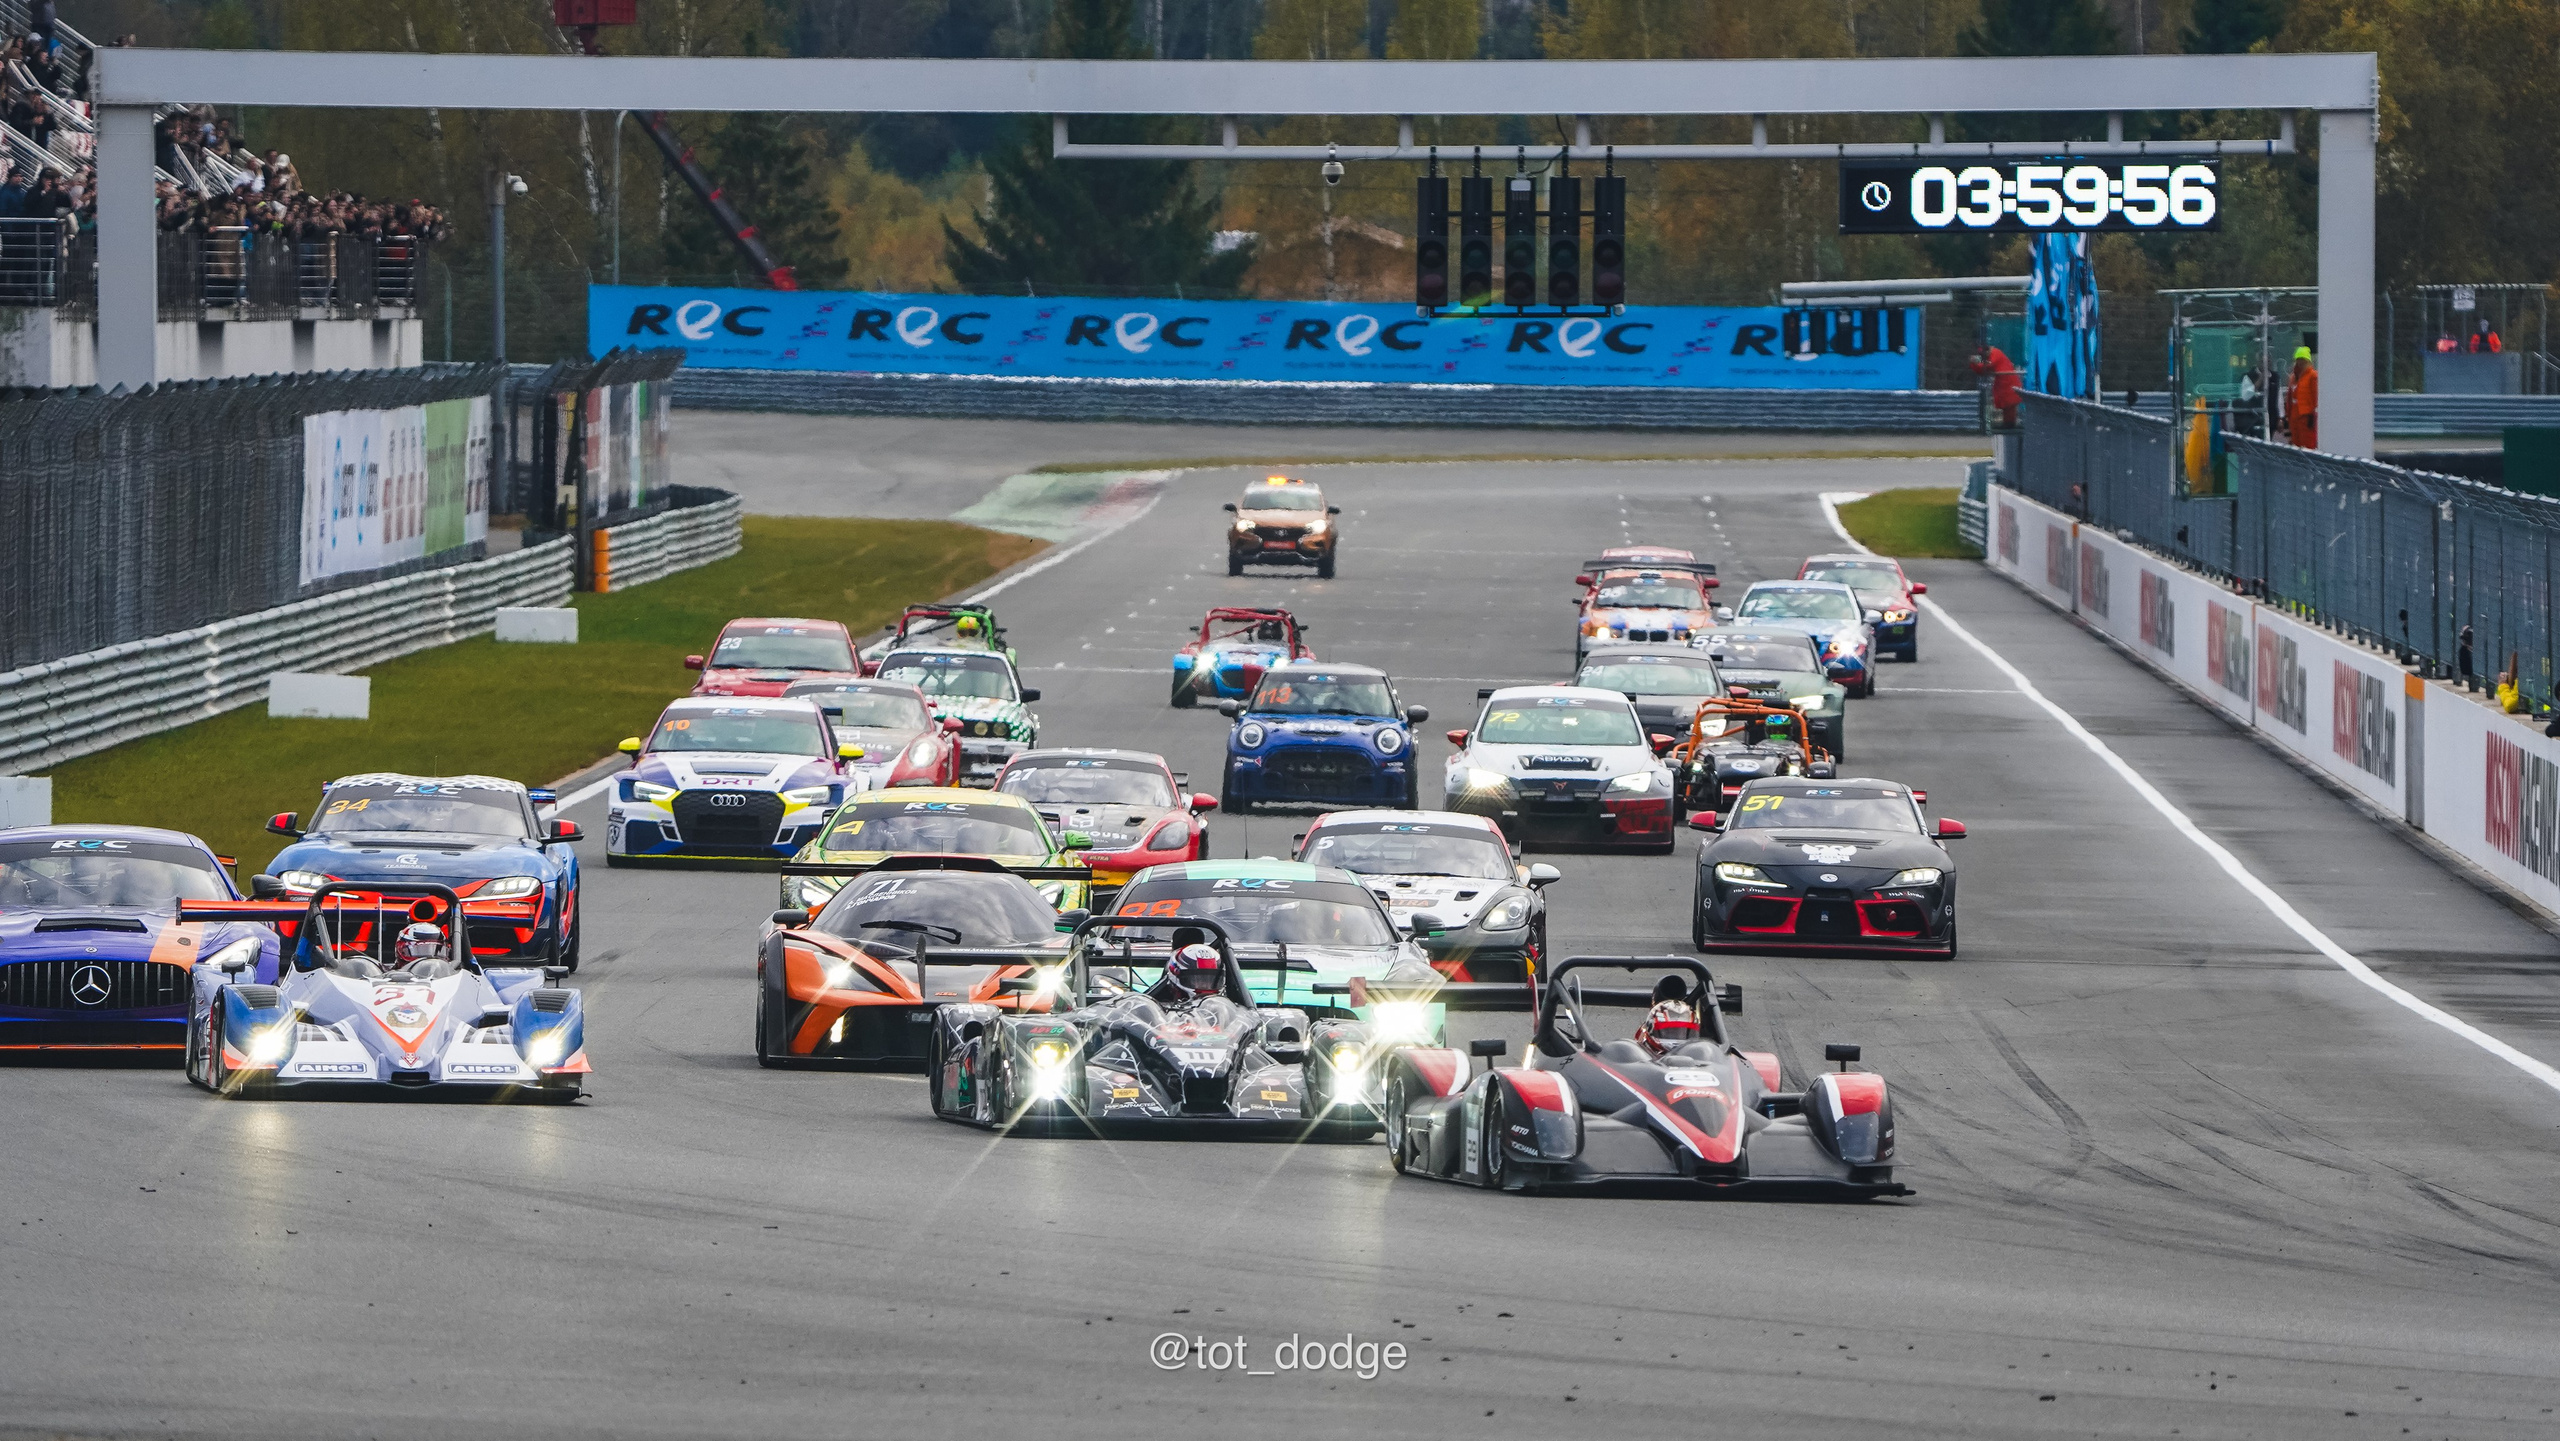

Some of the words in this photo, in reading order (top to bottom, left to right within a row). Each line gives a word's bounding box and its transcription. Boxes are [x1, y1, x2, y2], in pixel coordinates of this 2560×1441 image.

[1910, 165, 2216, 228] 03:59:56
[718, 637, 743, 650] 23
[1691, 634, 1728, 648] 55
[1580, 665, 1605, 677] 24
[1256, 687, 1294, 707] 113
[1488, 712, 1520, 723] 72
[663, 719, 691, 732] 10
[701, 777, 760, 786] DRT
[1005, 767, 1038, 784] 27
[325, 798, 371, 815] 34
[1742, 794, 1785, 811] 51
[831, 820, 866, 836] 4
[1316, 835, 1335, 850] 5
[868, 878, 907, 895] 71
[1185, 1051, 1215, 1060] 111
[300, 1063, 363, 1073] AIMOL
[452, 1064, 516, 1074] AIMOL
